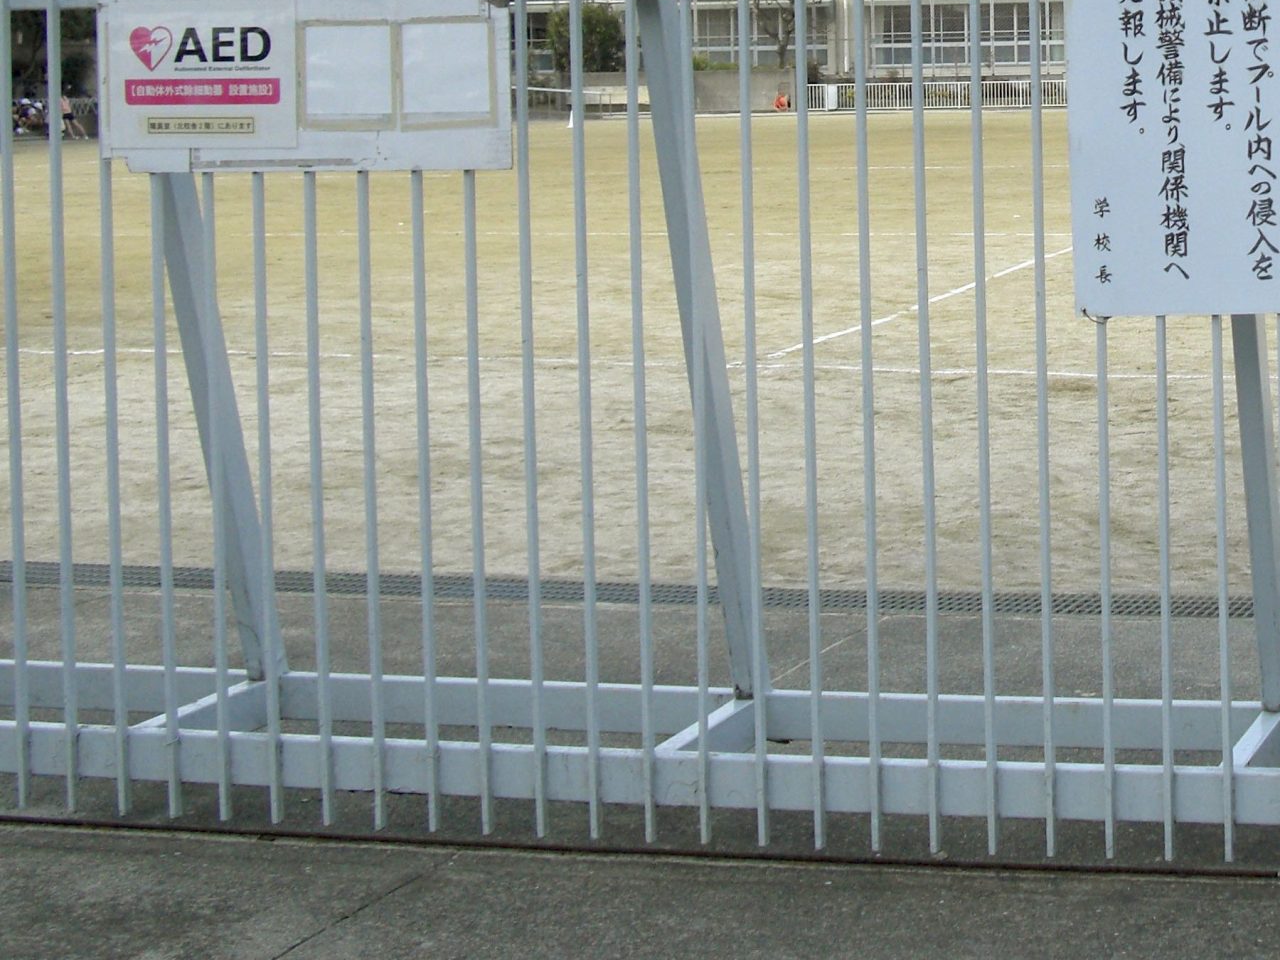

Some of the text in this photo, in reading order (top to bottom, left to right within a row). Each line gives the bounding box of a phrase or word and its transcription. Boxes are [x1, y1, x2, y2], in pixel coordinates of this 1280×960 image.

[173, 26, 272, 64] AED
[1092, 197, 1113, 284] 学校長
